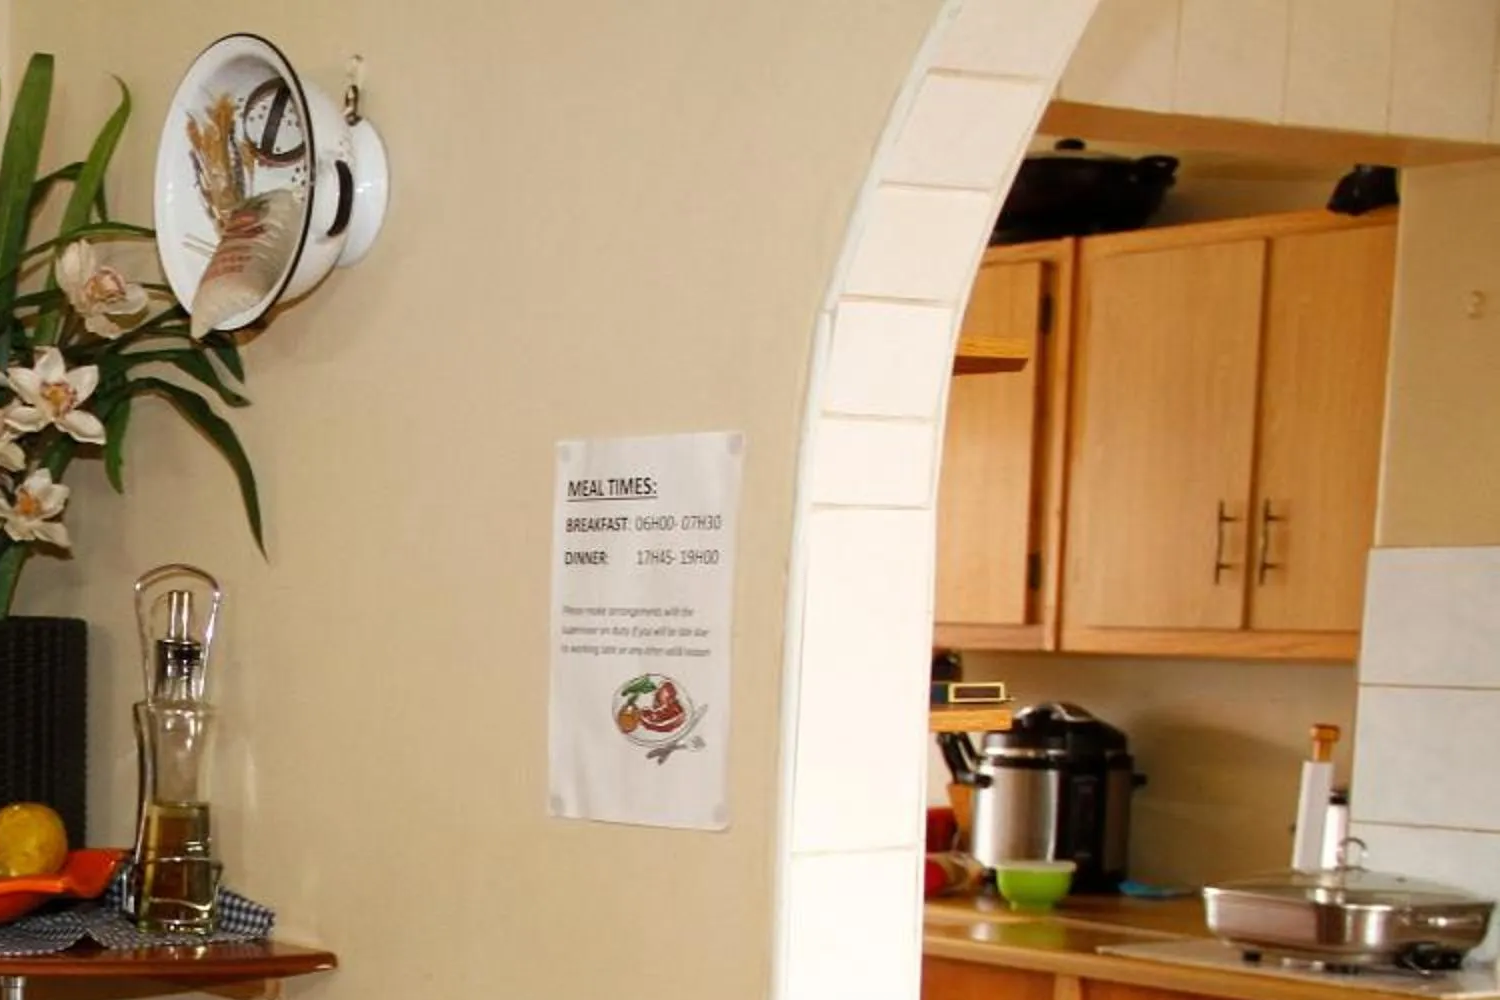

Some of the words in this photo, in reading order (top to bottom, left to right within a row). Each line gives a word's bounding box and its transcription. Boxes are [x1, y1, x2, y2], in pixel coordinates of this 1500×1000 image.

[567, 479, 604, 497] MEAL
[607, 477, 658, 495] TIMES:
[681, 514, 722, 531] 07H30
[680, 549, 720, 565] 19H00
